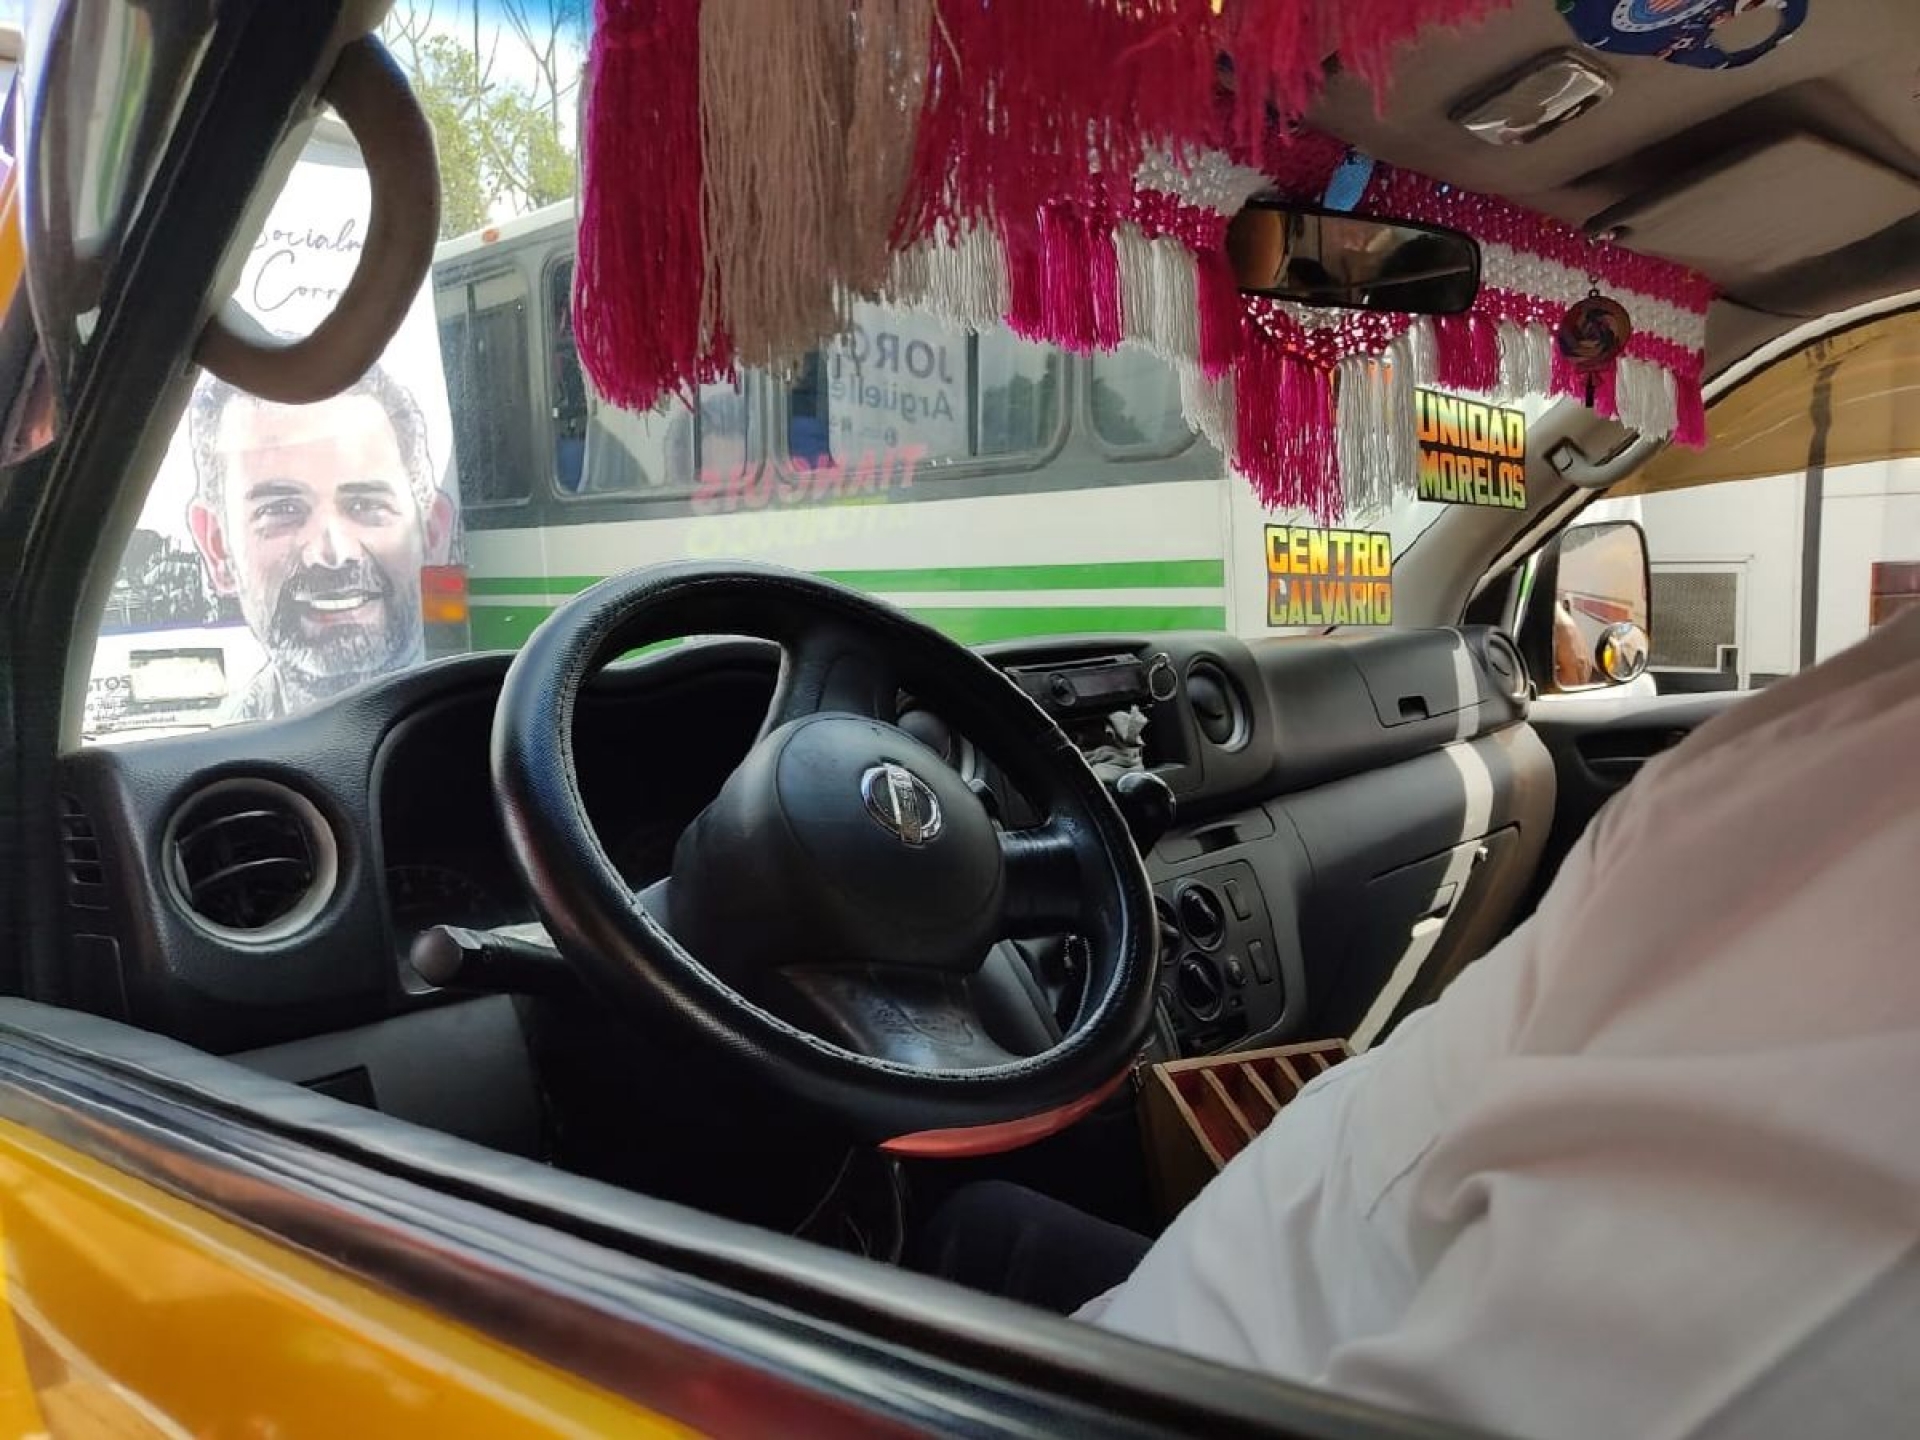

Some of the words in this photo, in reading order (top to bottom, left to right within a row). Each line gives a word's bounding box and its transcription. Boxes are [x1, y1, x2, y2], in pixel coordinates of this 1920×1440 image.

[254, 249, 342, 312] Corr
[1415, 390, 1524, 458] UNIDAD
[1418, 448, 1526, 509] MORELOS
[1266, 527, 1391, 577] CENTRO
[1268, 578, 1393, 625] CALVARIO
